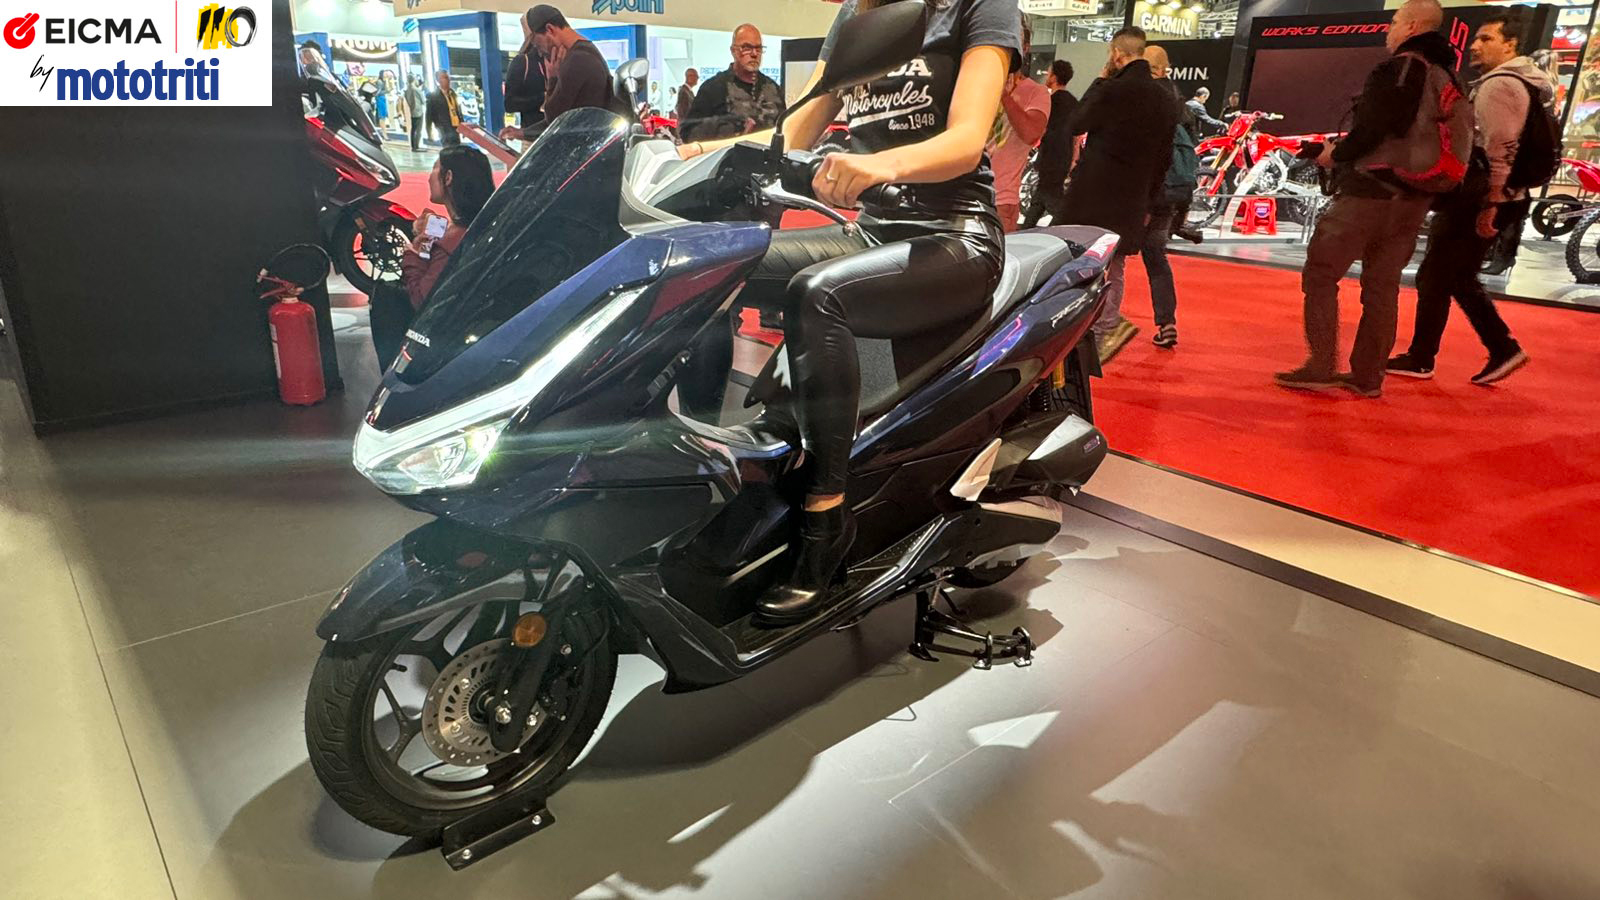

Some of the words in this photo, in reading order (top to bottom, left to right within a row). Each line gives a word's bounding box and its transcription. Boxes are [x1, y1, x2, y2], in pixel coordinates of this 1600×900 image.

[1141, 12, 1192, 36] GARMIN
[1261, 26, 1319, 37] WORKS
[842, 81, 933, 114] Motorcycles
[908, 113, 935, 130] 1948
